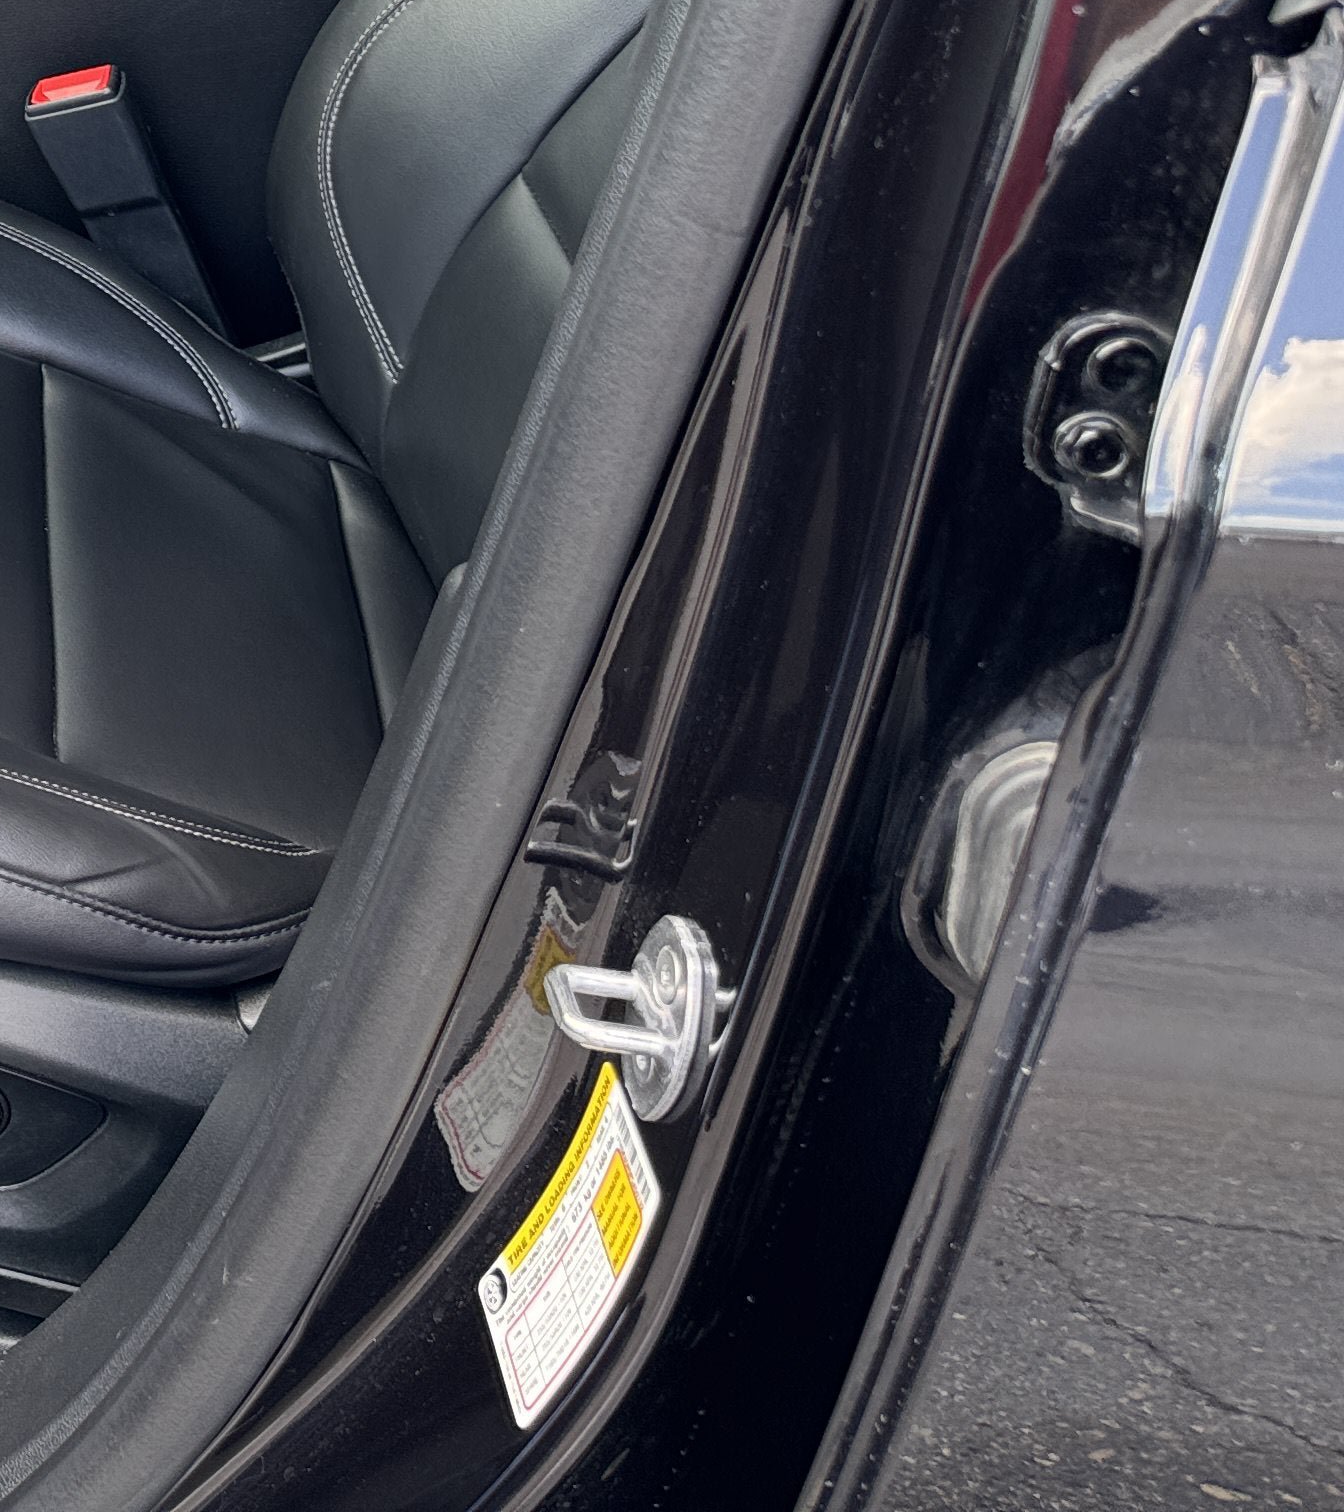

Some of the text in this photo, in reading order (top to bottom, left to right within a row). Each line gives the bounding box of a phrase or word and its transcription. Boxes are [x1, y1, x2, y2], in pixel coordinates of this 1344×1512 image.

[507, 1075, 611, 1265] TIRE AND LOADING INFORMATION
